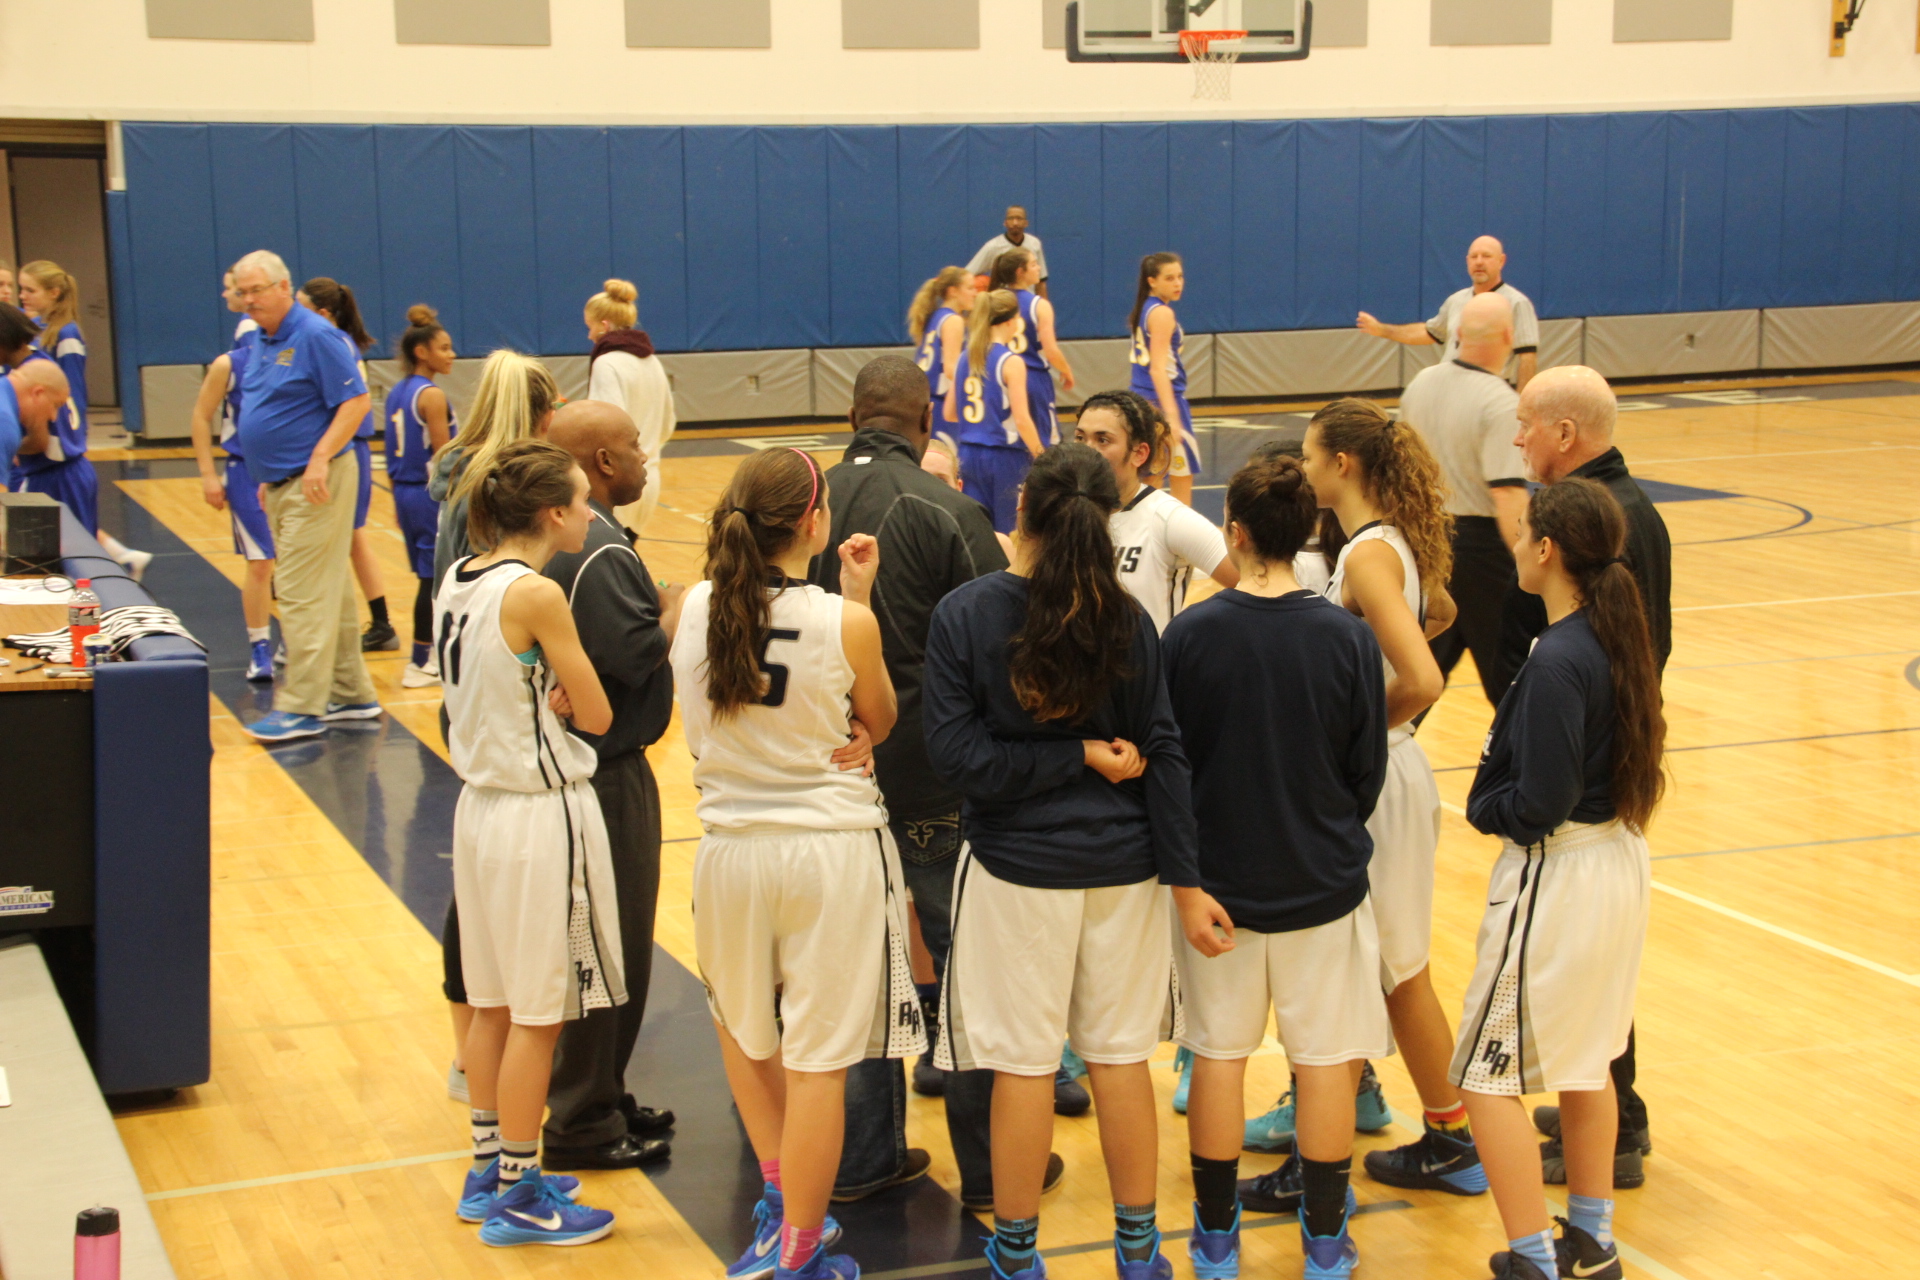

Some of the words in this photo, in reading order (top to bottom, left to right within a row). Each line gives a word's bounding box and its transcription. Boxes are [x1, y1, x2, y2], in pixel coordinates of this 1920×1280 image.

[963, 376, 985, 424] 3
[745, 627, 802, 709] 5
[0, 893, 52, 905] MERICAN
[1481, 1040, 1511, 1076] RR
